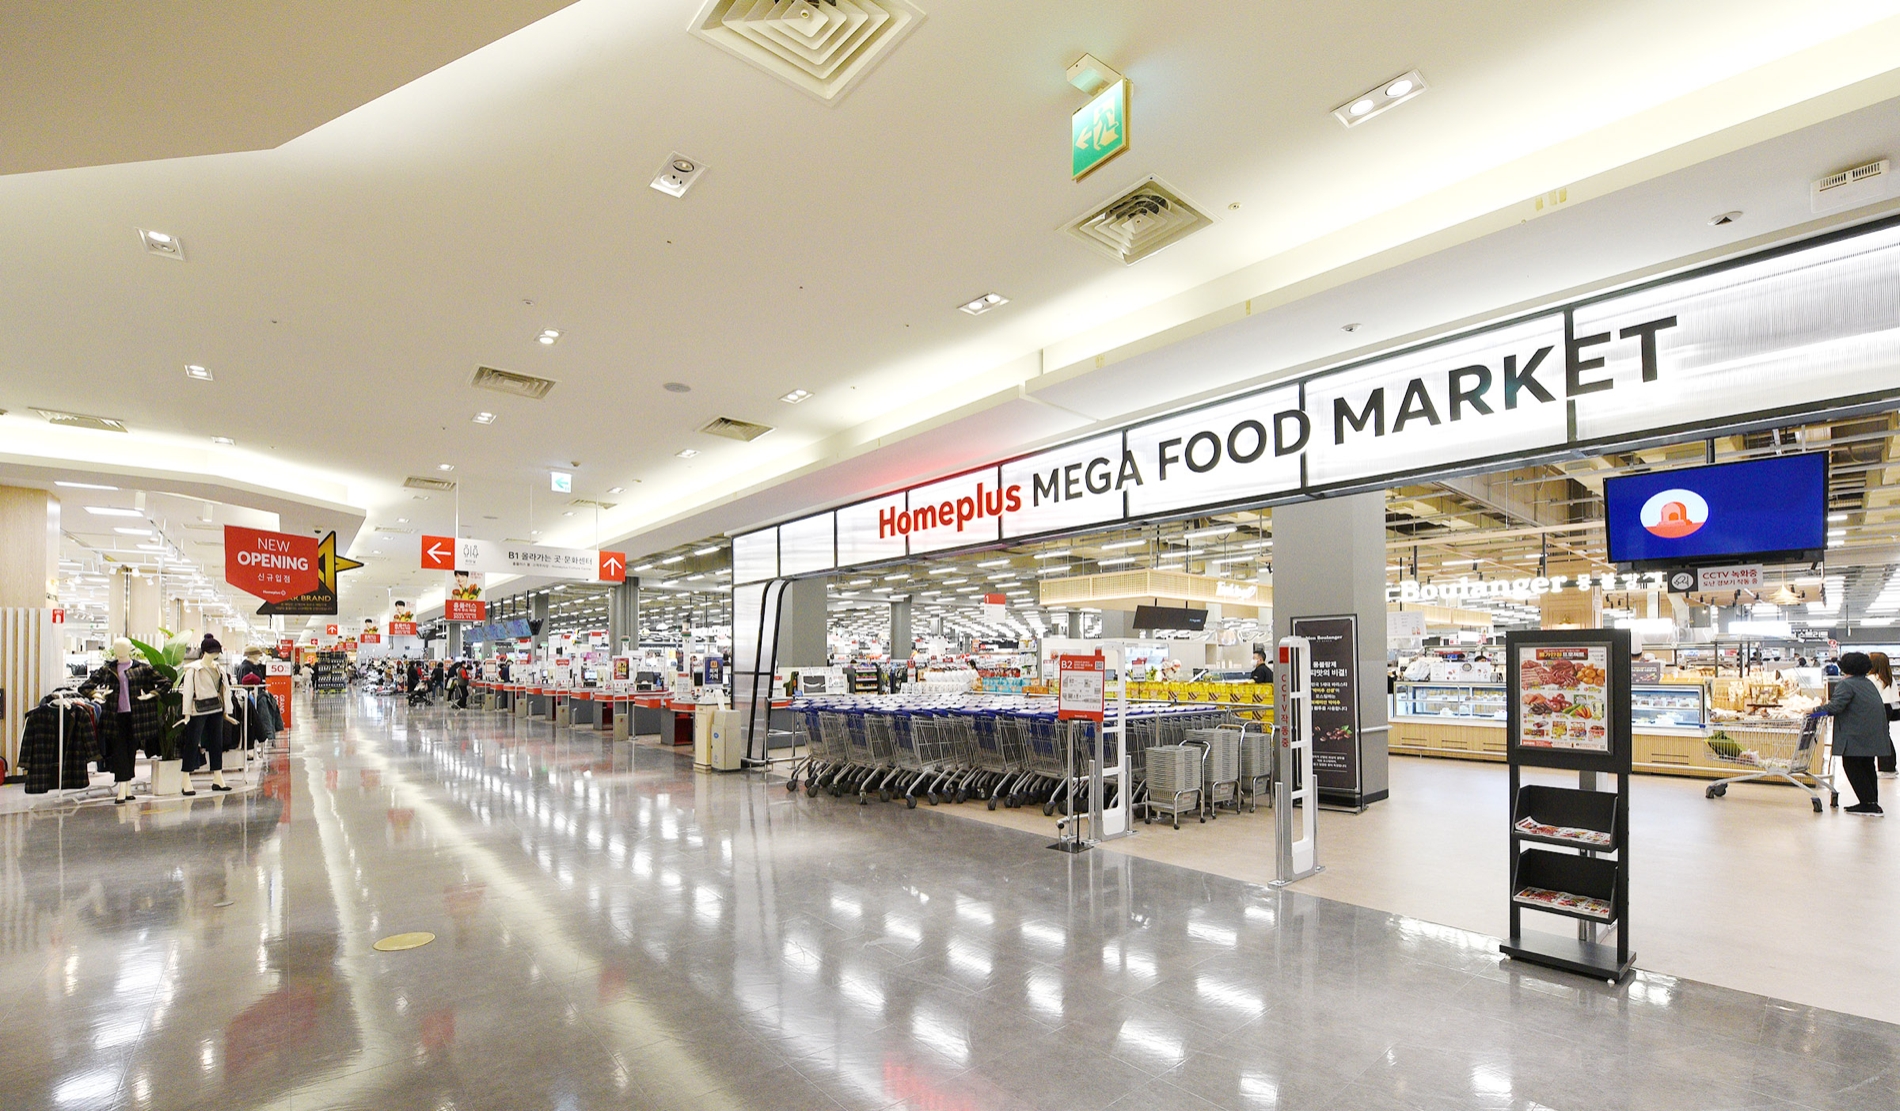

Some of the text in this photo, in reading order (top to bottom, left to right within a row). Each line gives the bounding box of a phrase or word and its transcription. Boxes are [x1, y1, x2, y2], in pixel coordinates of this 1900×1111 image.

[879, 315, 1678, 539] Homeplus MEGA FOOD MARKET
[257, 537, 290, 553] NEW
[508, 551, 519, 560] B1
[237, 551, 309, 571] OPENING
[258, 573, 291, 583] 신규입점
[1702, 571, 1729, 580] CCTV
[1400, 574, 1567, 600] Boulanger
[301, 594, 332, 602] BRAND
[1061, 660, 1073, 669] B2
